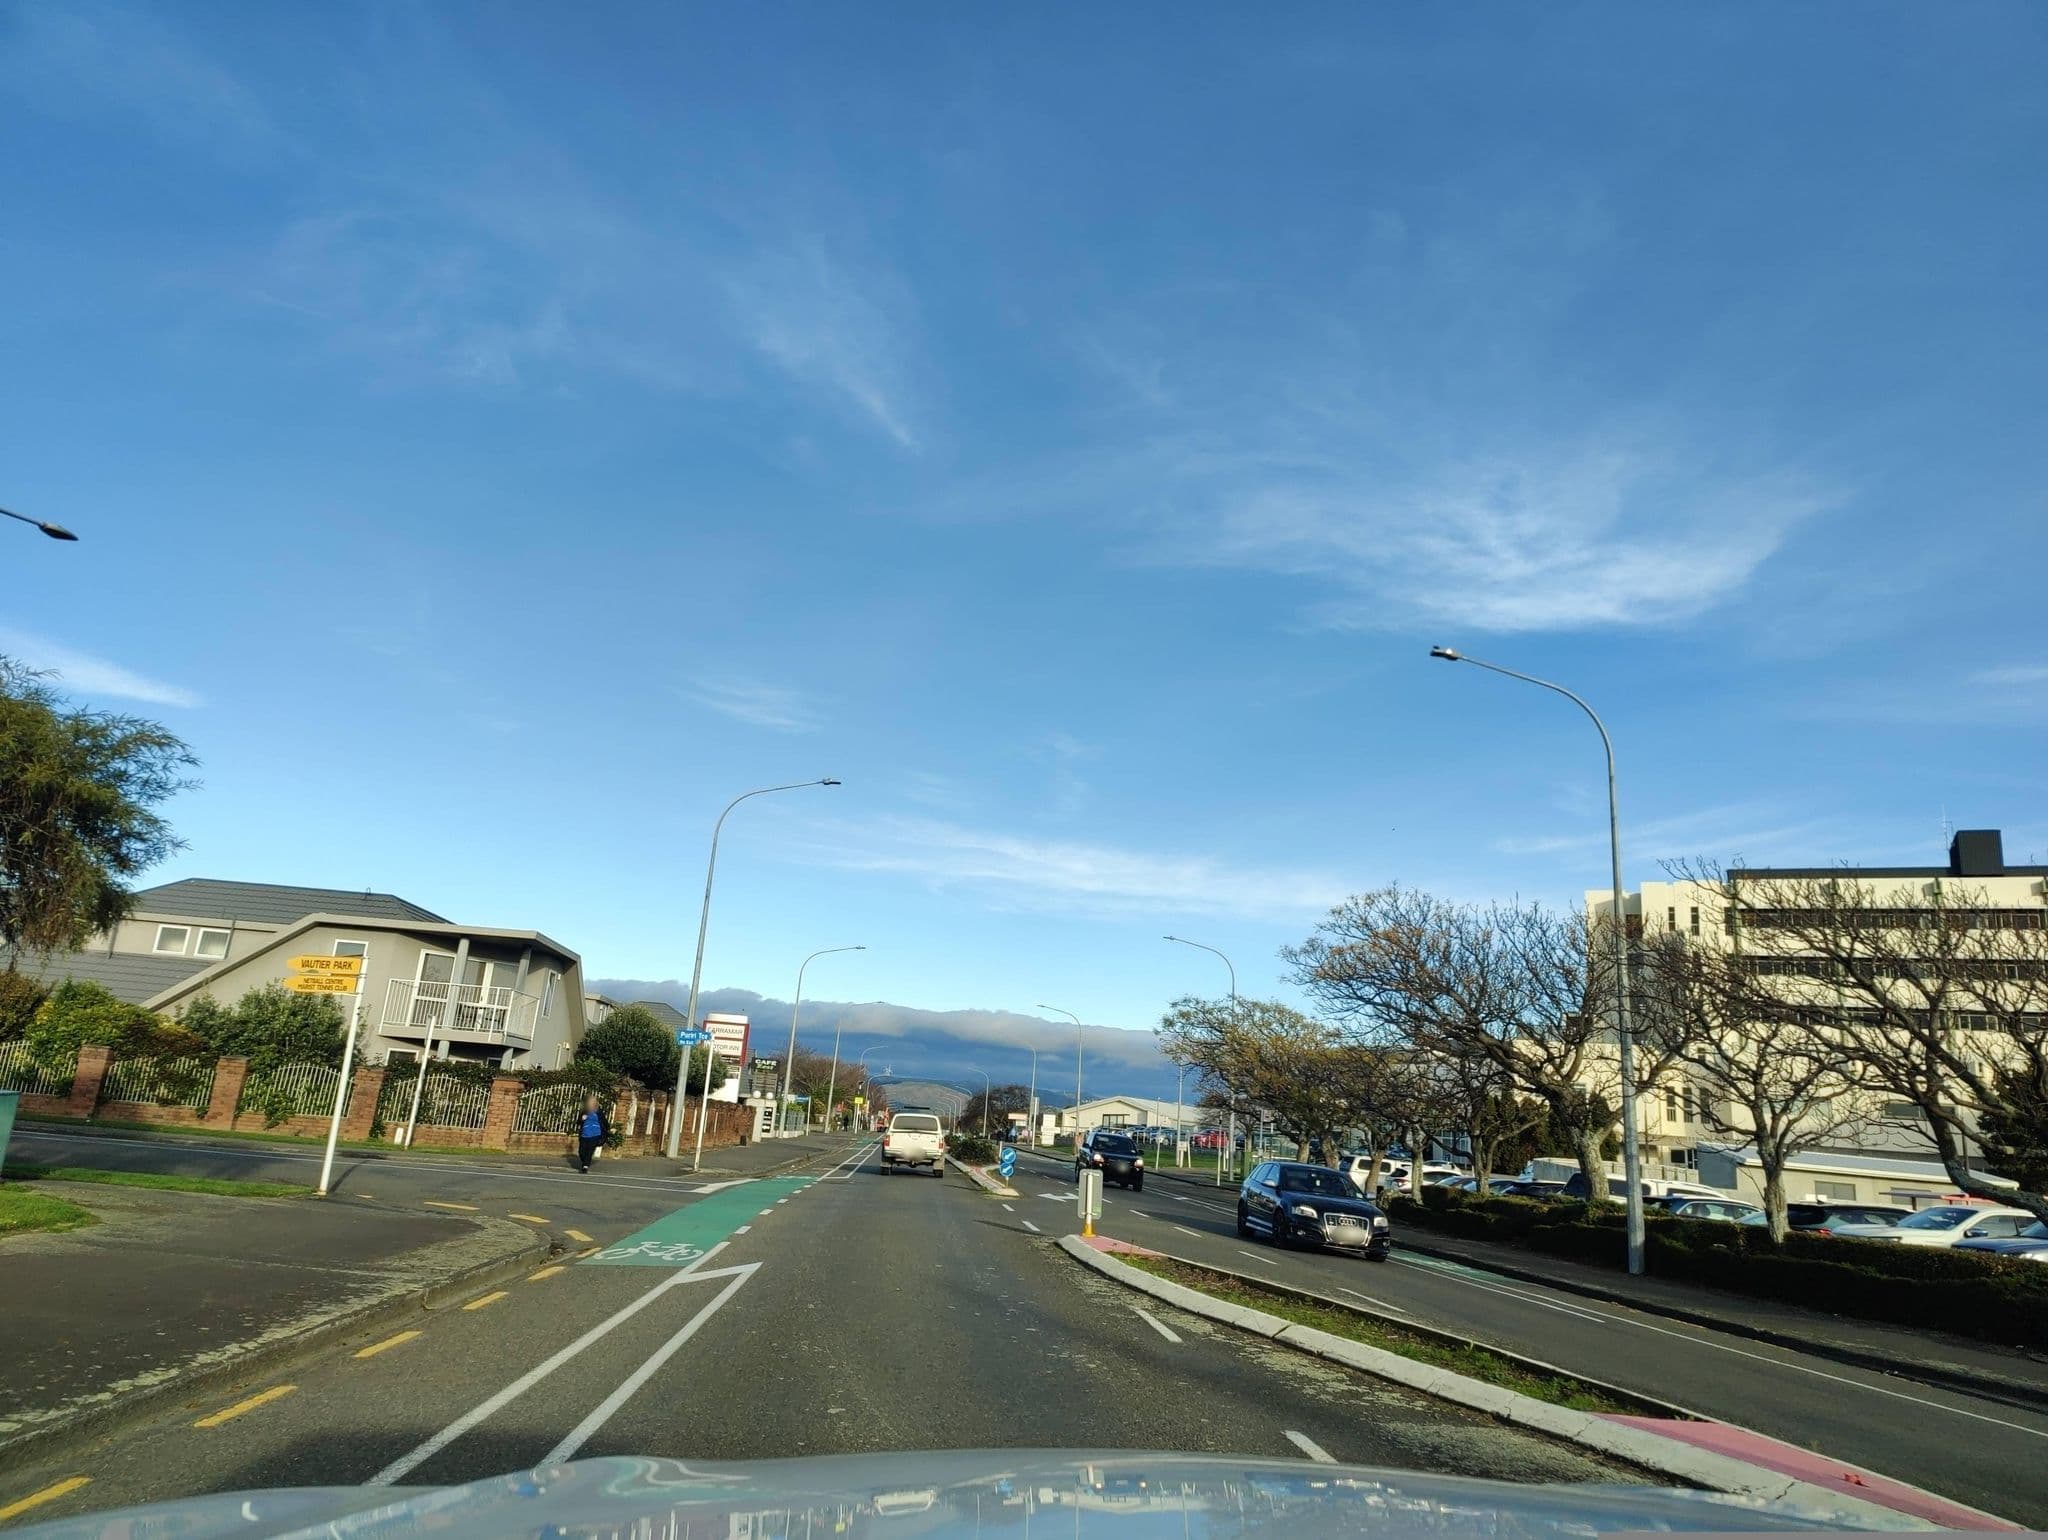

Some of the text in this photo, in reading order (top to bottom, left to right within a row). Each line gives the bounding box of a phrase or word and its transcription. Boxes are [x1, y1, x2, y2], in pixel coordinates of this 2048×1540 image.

[301, 960, 353, 970] VAUTIER PARK
[680, 1031, 709, 1040] Puriri Tce
